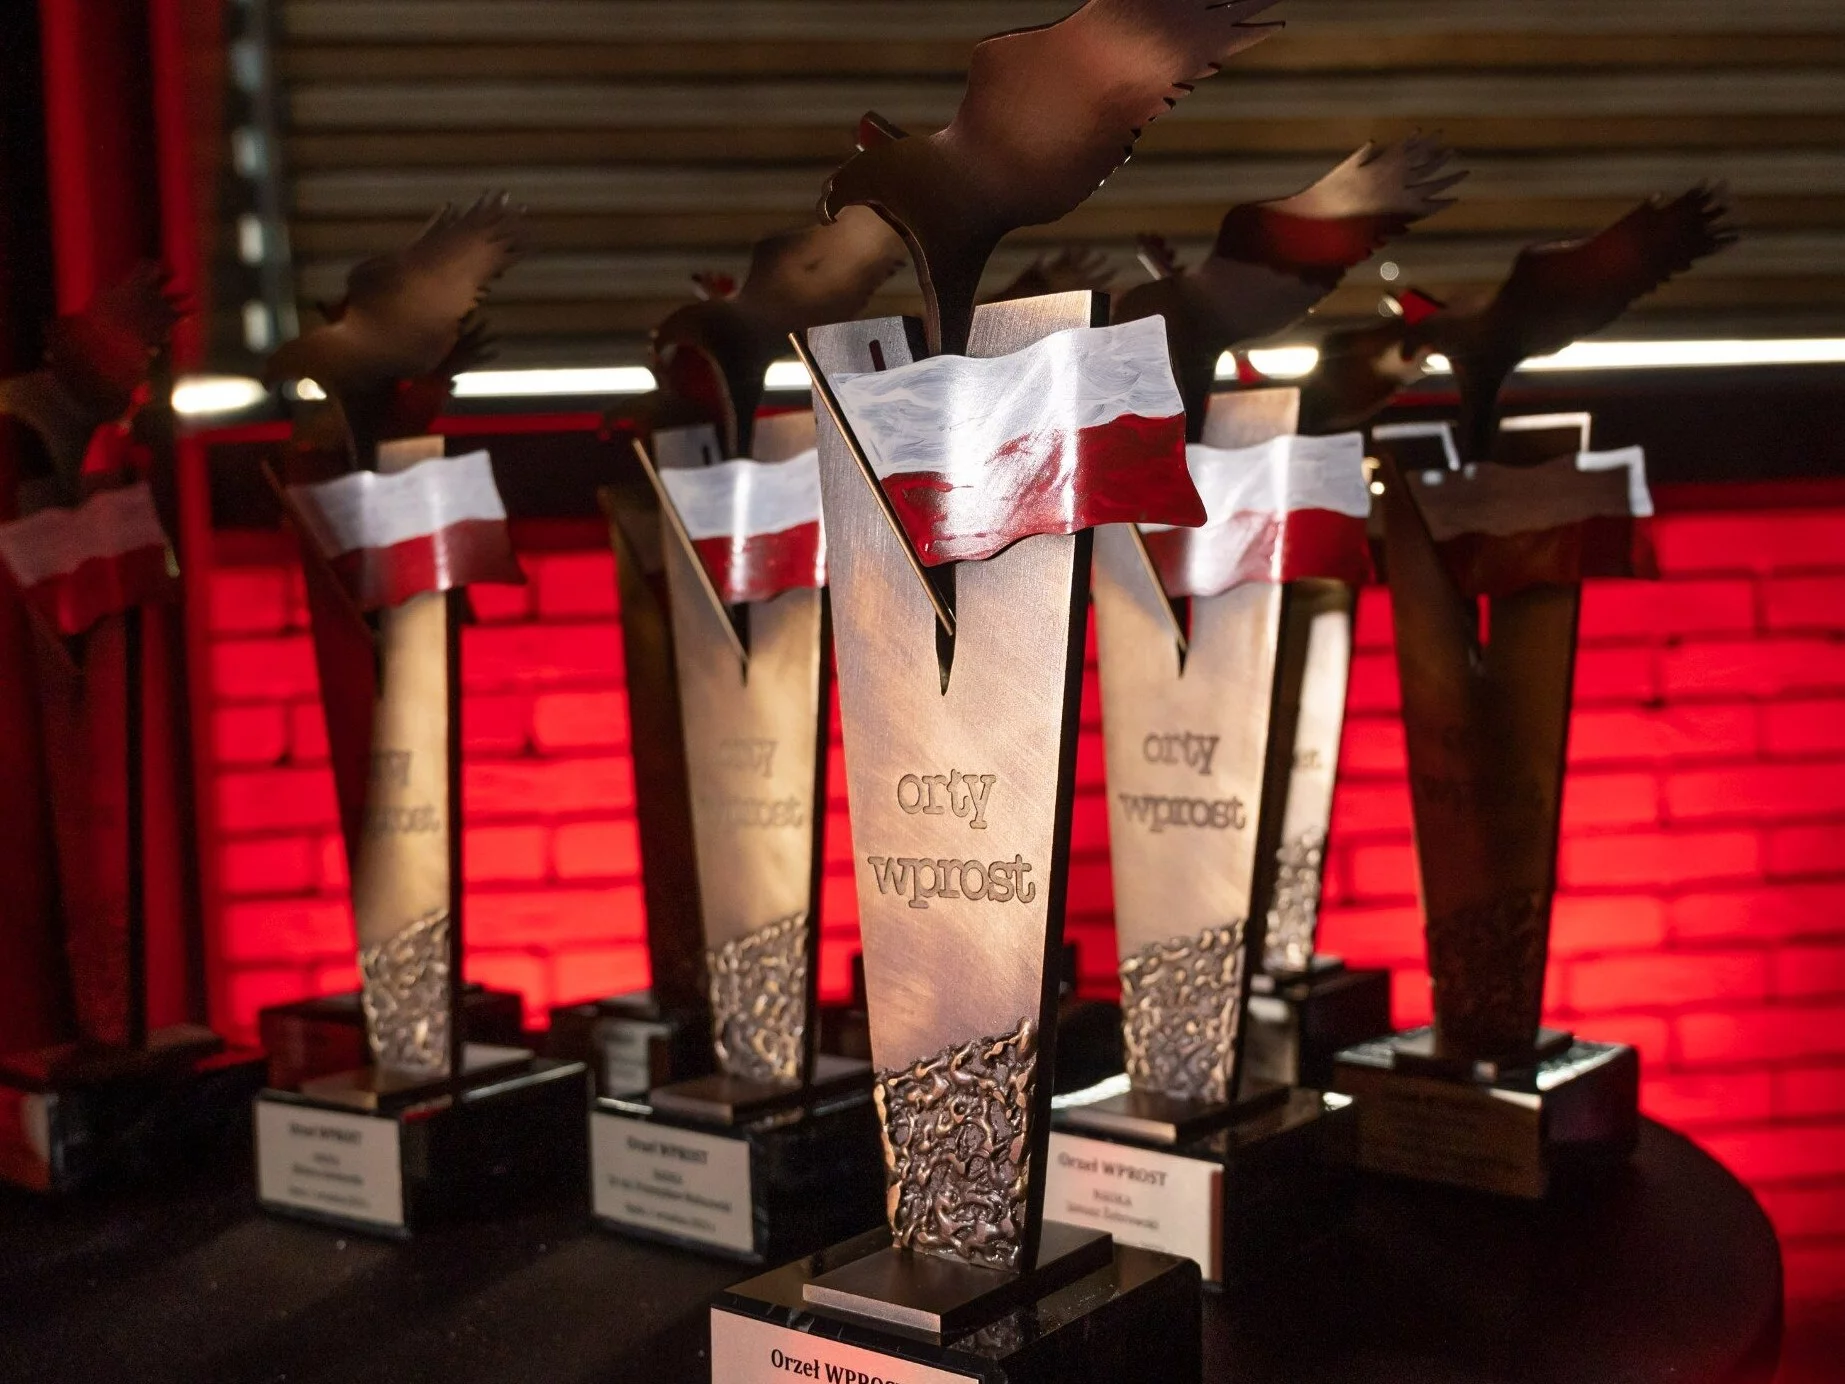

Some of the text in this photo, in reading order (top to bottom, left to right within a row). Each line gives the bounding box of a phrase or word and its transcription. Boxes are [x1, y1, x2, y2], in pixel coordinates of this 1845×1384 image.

[1118, 796, 1246, 832] wprost
[867, 853, 1036, 909] wprost
[771, 1348, 820, 1379] Orzeł
